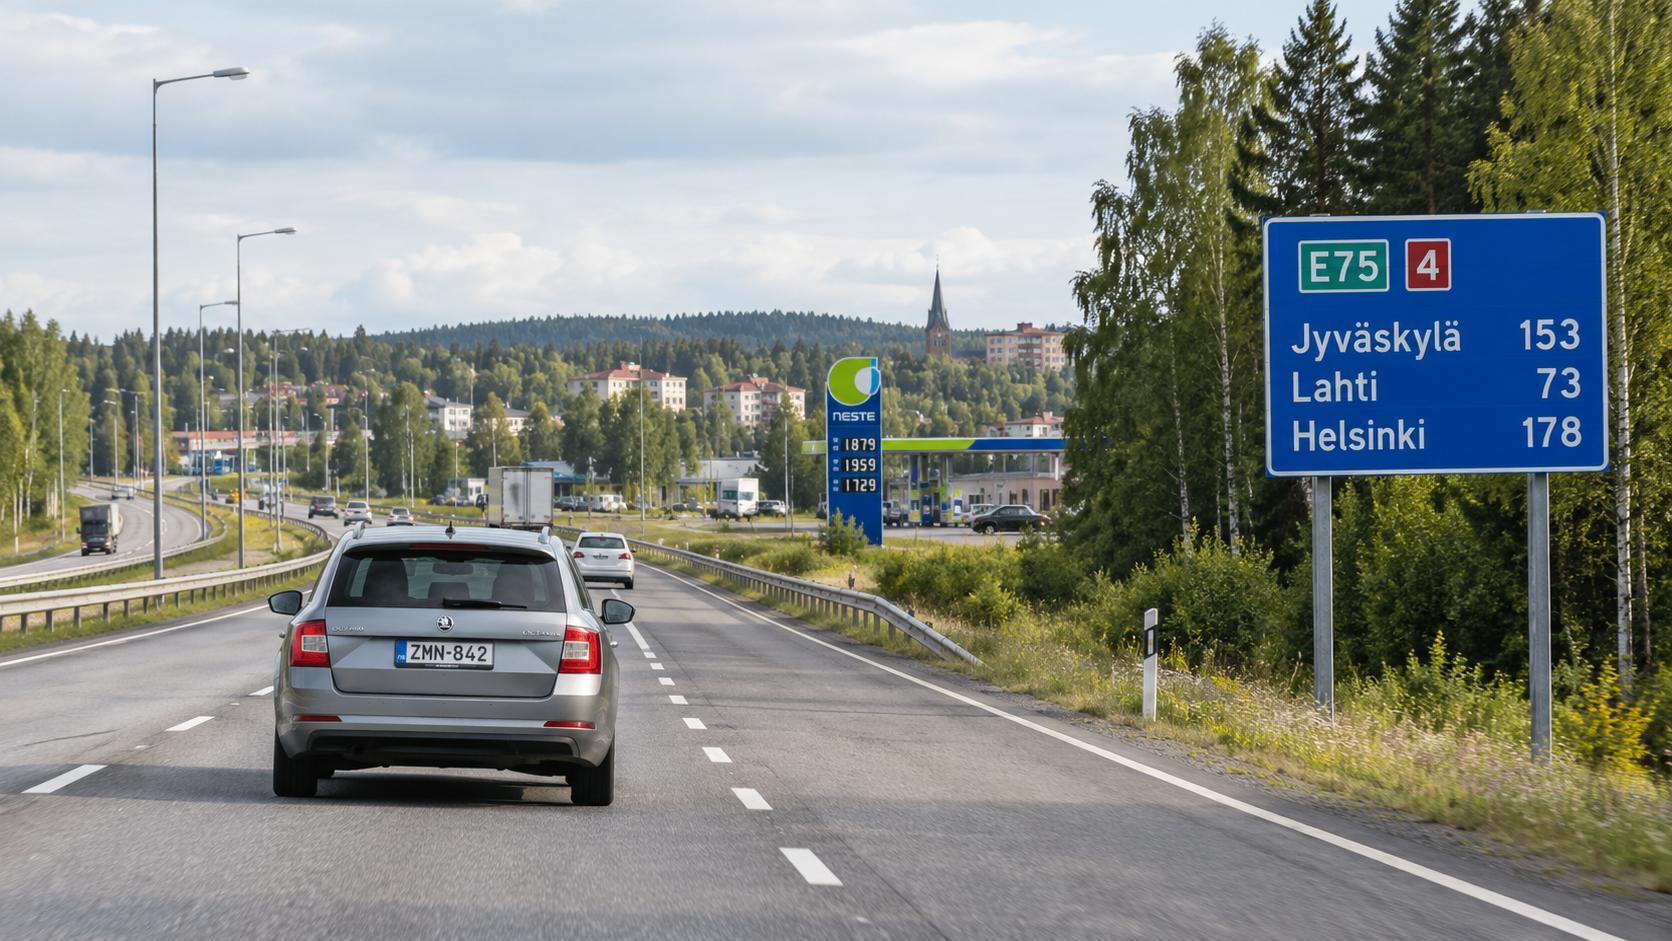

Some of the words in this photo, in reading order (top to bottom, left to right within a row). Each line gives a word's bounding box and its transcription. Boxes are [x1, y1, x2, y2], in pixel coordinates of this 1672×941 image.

[1310, 250, 1379, 282] E75
[1416, 249, 1440, 281] 4
[1291, 320, 1461, 361] Jyväskylä
[1519, 318, 1581, 351] 153
[1292, 371, 1377, 403] Lahti
[1536, 367, 1581, 399] 73
[832, 411, 876, 422] NESTE
[1293, 418, 1425, 452] Helsinki
[1522, 416, 1582, 448] 178
[845, 438, 876, 451] 1879
[845, 458, 876, 472] 1959
[846, 478, 876, 492] 1729
[410, 644, 488, 662] ZMN-842
